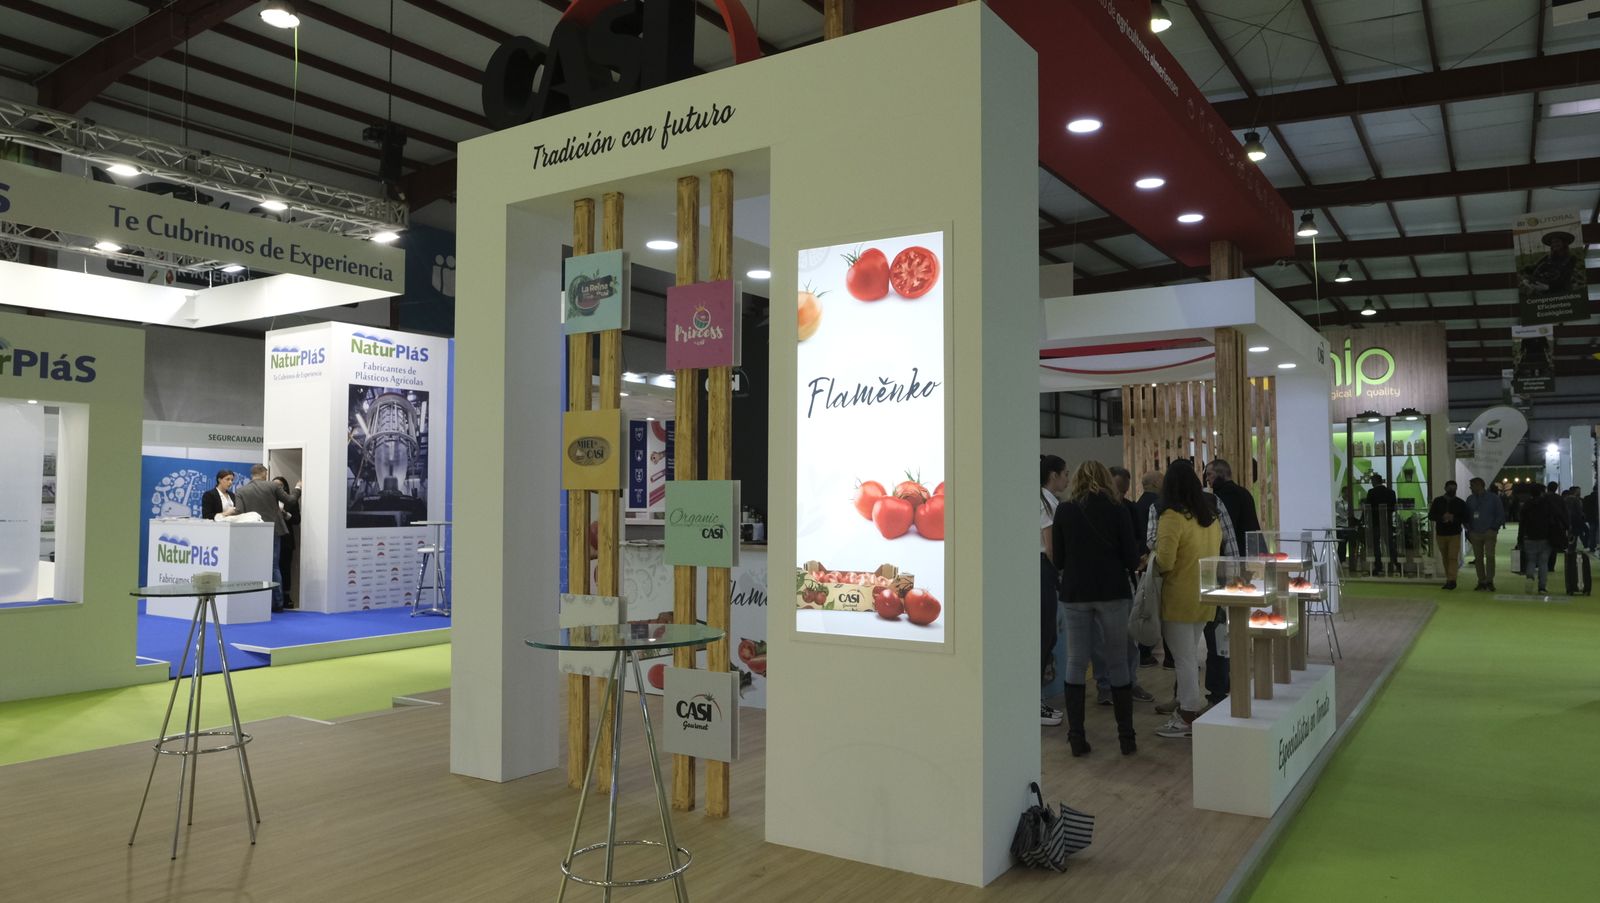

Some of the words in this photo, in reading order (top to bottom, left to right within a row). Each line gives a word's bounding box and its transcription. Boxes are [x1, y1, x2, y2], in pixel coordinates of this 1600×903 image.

[532, 130, 616, 170] Tradición
[621, 124, 656, 148] con
[661, 103, 736, 149] futuro
[108, 204, 140, 232] Te
[146, 213, 254, 255] Cubrimos
[259, 236, 284, 260] de
[289, 243, 393, 281] Experiencia
[675, 323, 725, 343] Princess
[271, 347, 325, 369] NaturPláS
[351, 338, 429, 363] NaturPláS
[355, 371, 389, 383] Plásticos
[363, 361, 407, 375] Fabricantes
[408, 366, 417, 375] de
[1366, 386, 1401, 399] quality
[669, 507, 720, 527] Organic
[701, 528, 723, 539] CASI
[157, 543, 219, 567] NaturPláS
[838, 593, 860, 604] CASI
[675, 700, 713, 723] CASI
